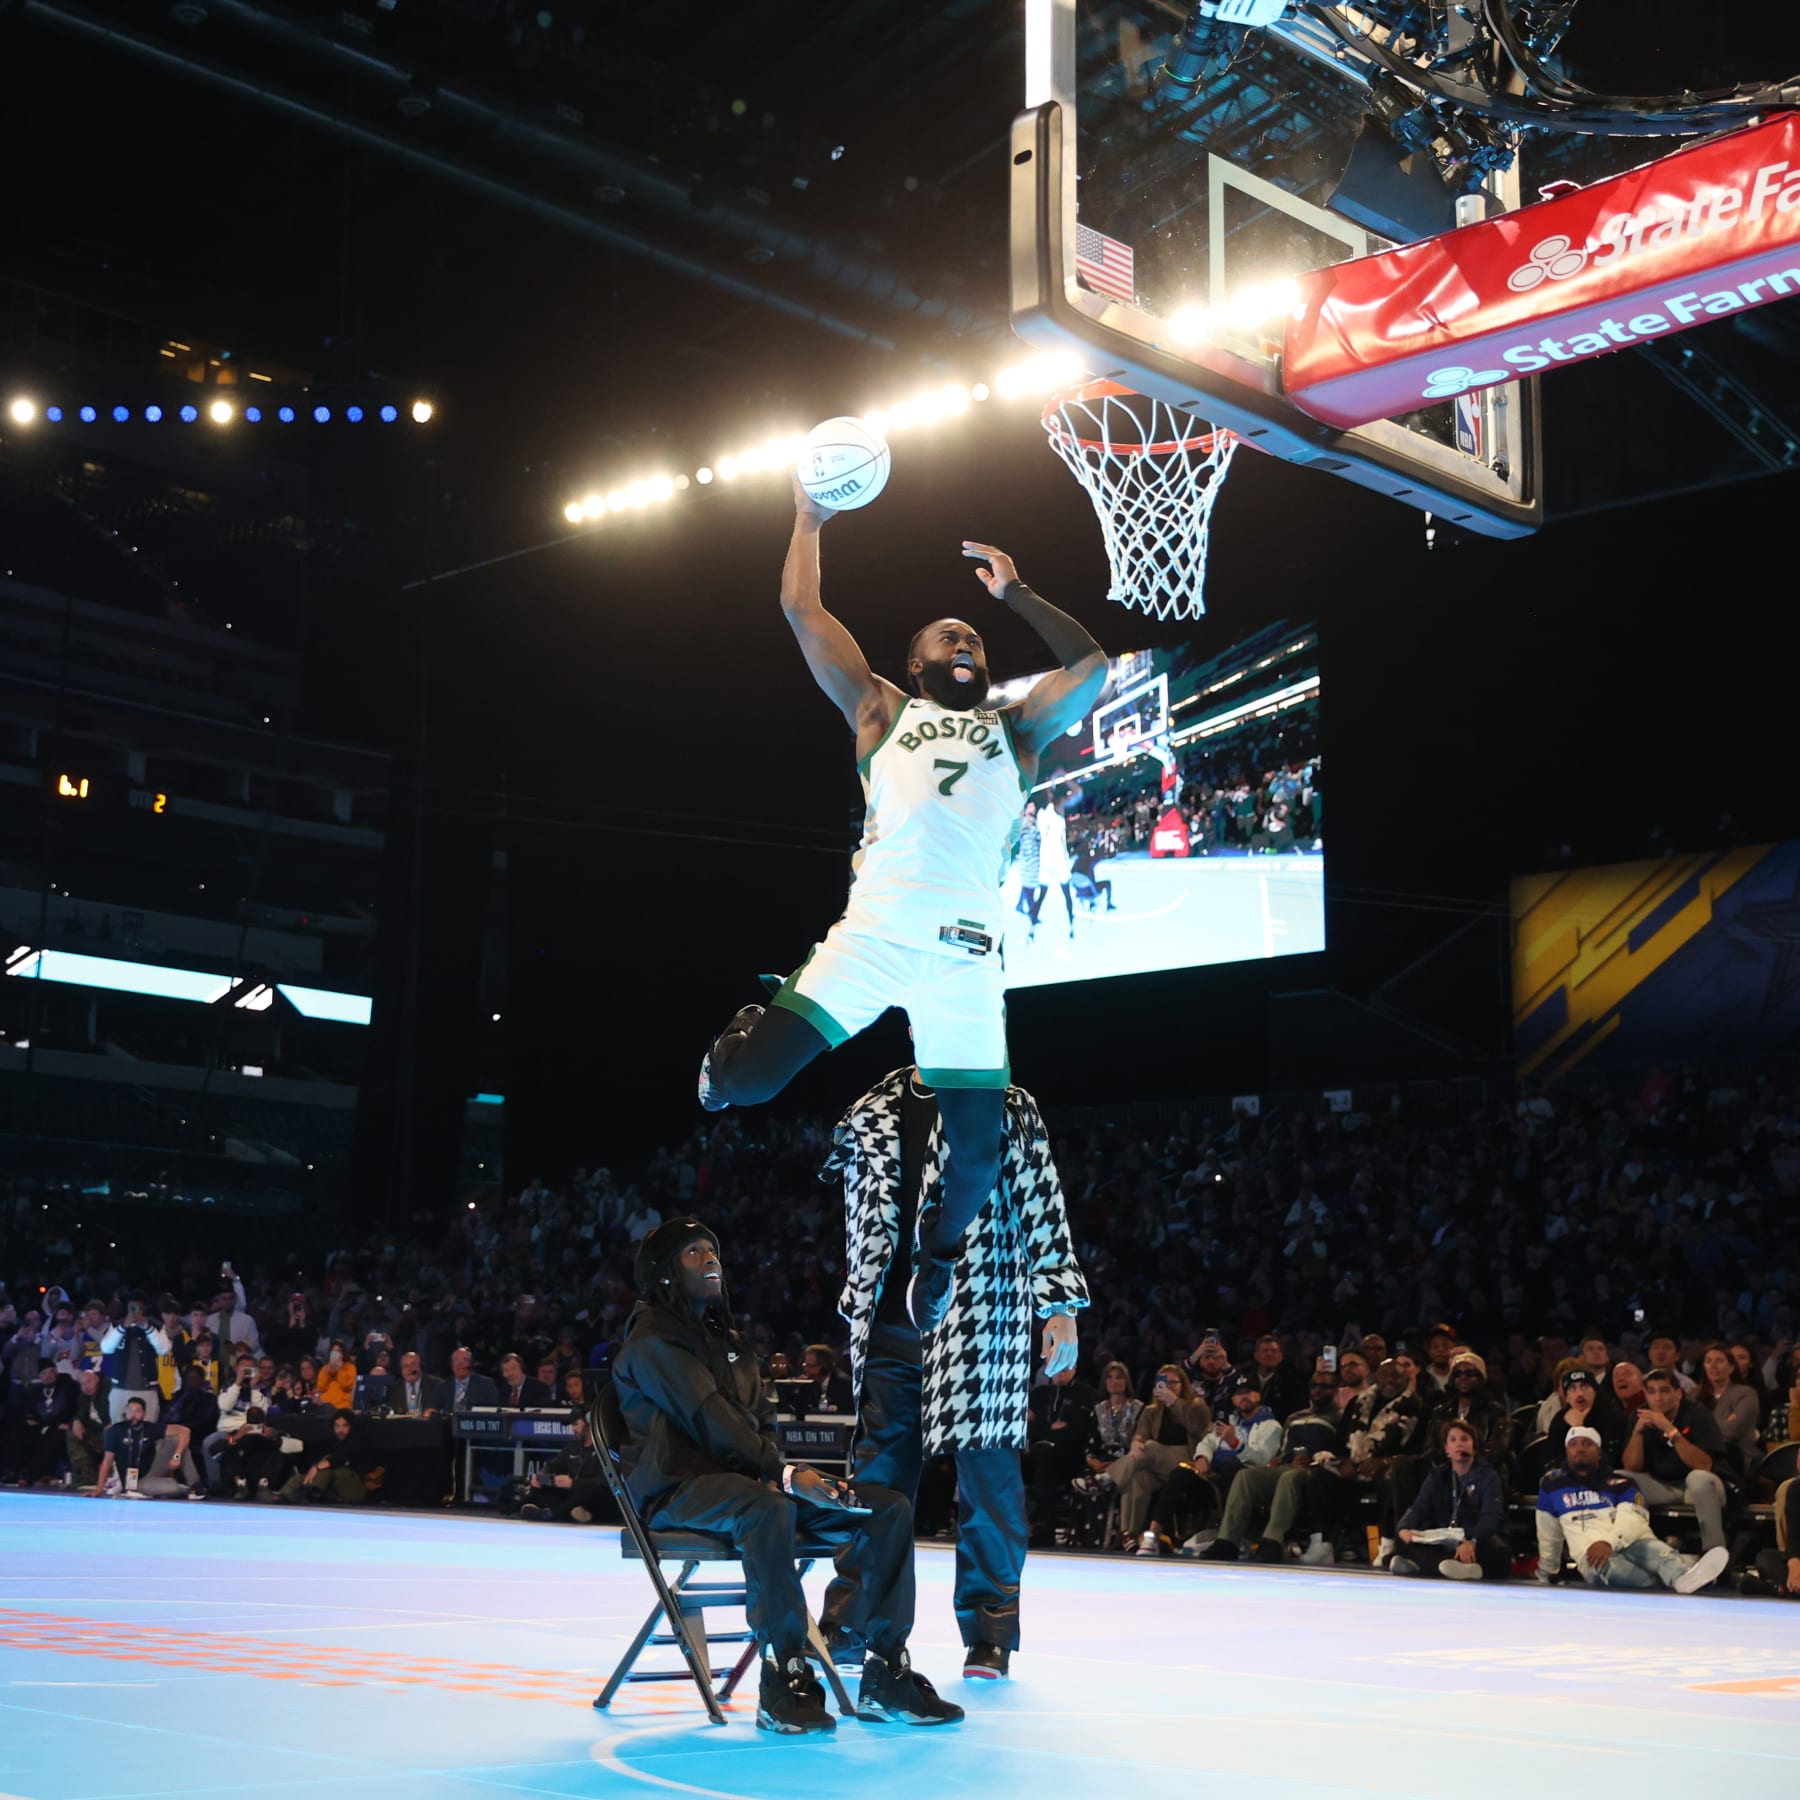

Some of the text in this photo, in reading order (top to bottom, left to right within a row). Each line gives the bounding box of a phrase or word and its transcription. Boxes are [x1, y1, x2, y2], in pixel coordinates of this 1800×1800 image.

[1460, 430, 1473, 450] NBA
[897, 716, 1003, 760] BOSTON
[933, 758, 969, 796] 7
[153, 793, 166, 813] 2
[460, 1420, 474, 1431] NBA
[487, 1420, 500, 1432] TNT
[786, 1431, 835, 1443] NBA ON TNT
